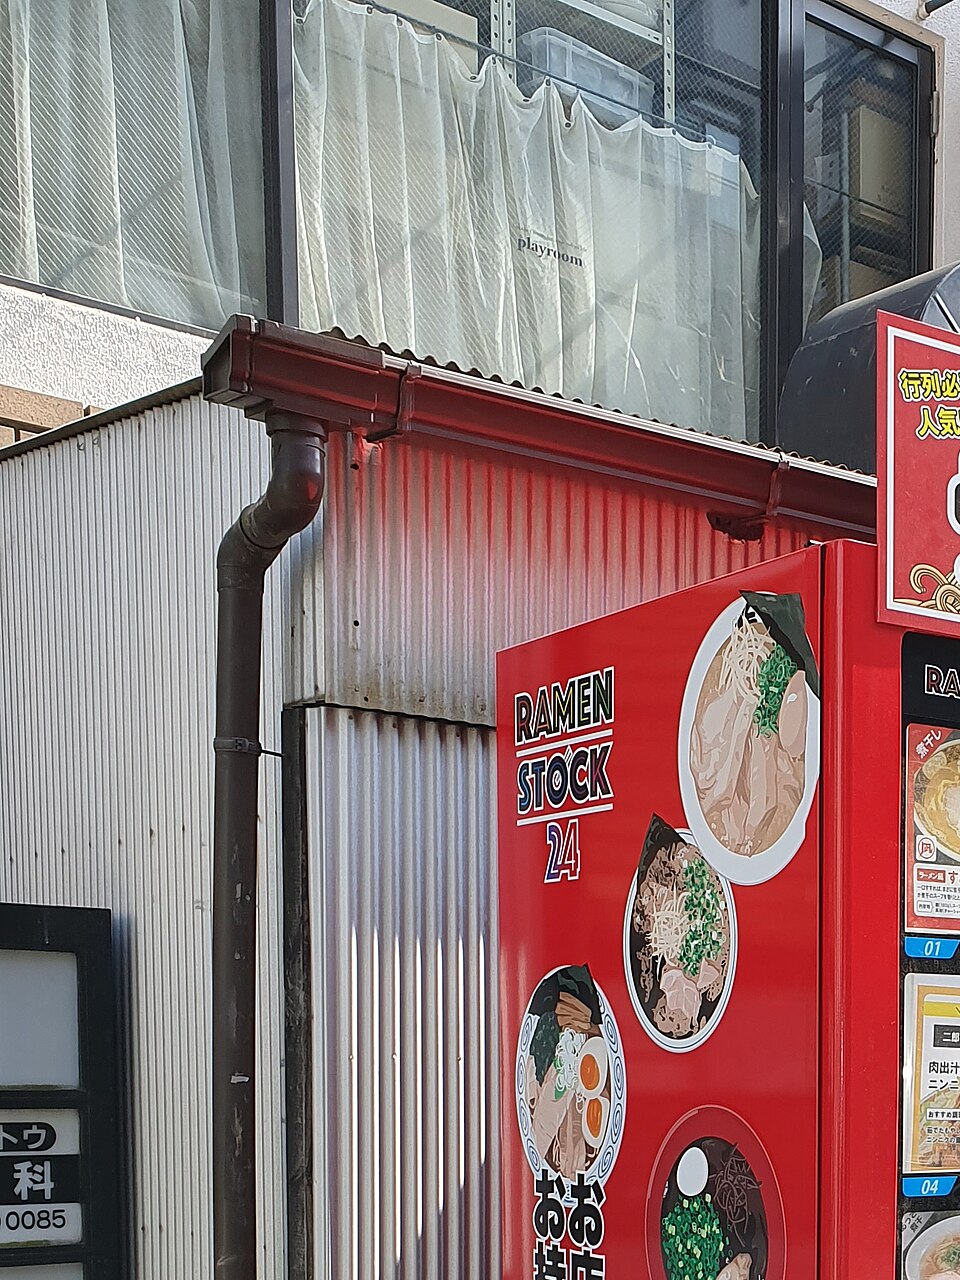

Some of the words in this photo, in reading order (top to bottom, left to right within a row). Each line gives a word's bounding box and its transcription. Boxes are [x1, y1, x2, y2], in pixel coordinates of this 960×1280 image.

[517, 236, 583, 267] playroom
[514, 666, 614, 746] RAMEN
[915, 728, 942, 759] 煮干し
[516, 741, 615, 817] STOCK
[543, 818, 581, 884] 24
[924, 941, 941, 957] 01
[13, 1160, 55, 1201] 科
[921, 1179, 939, 1195] 04
